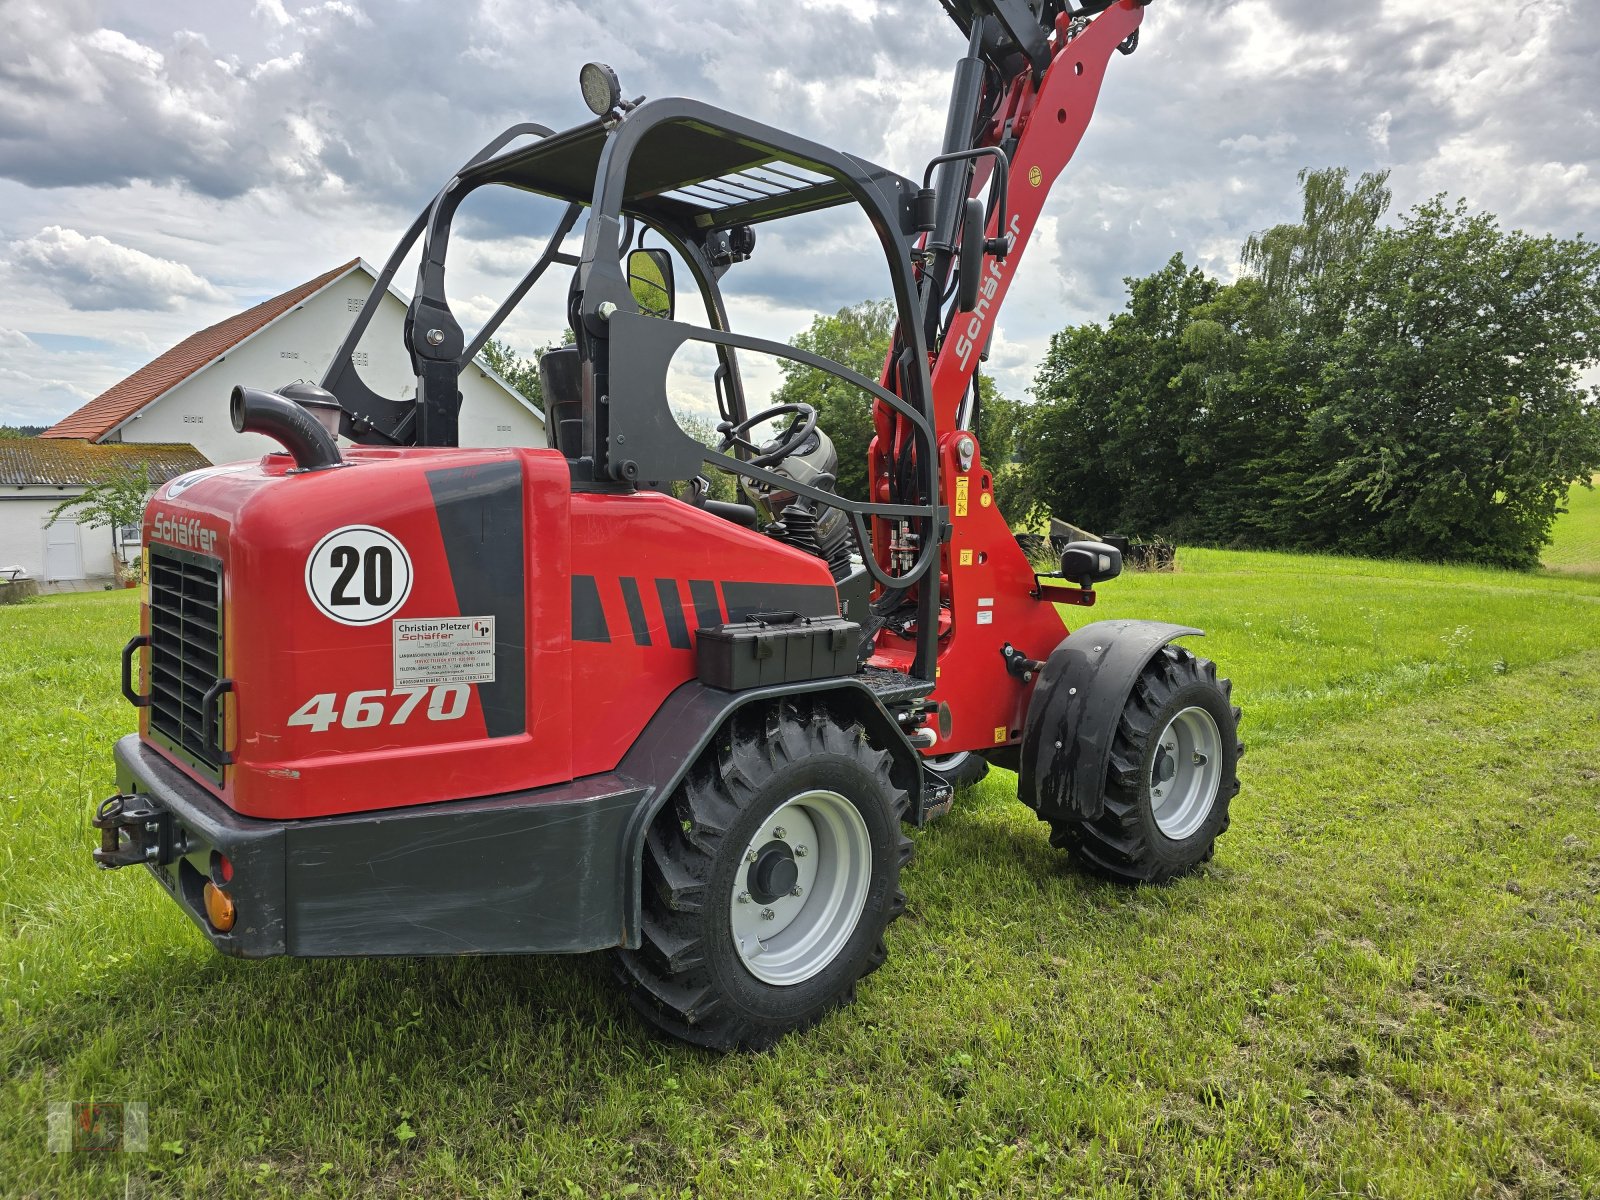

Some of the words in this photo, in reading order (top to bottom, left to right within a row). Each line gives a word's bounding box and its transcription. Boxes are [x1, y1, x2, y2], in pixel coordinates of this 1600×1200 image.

[955, 213, 1020, 372] Schäfer
[150, 511, 217, 552] Schäffer
[330, 545, 393, 607] 20
[398, 624, 438, 632] Christian
[399, 632, 454, 640] Schäffer
[286, 683, 470, 732] 4670
